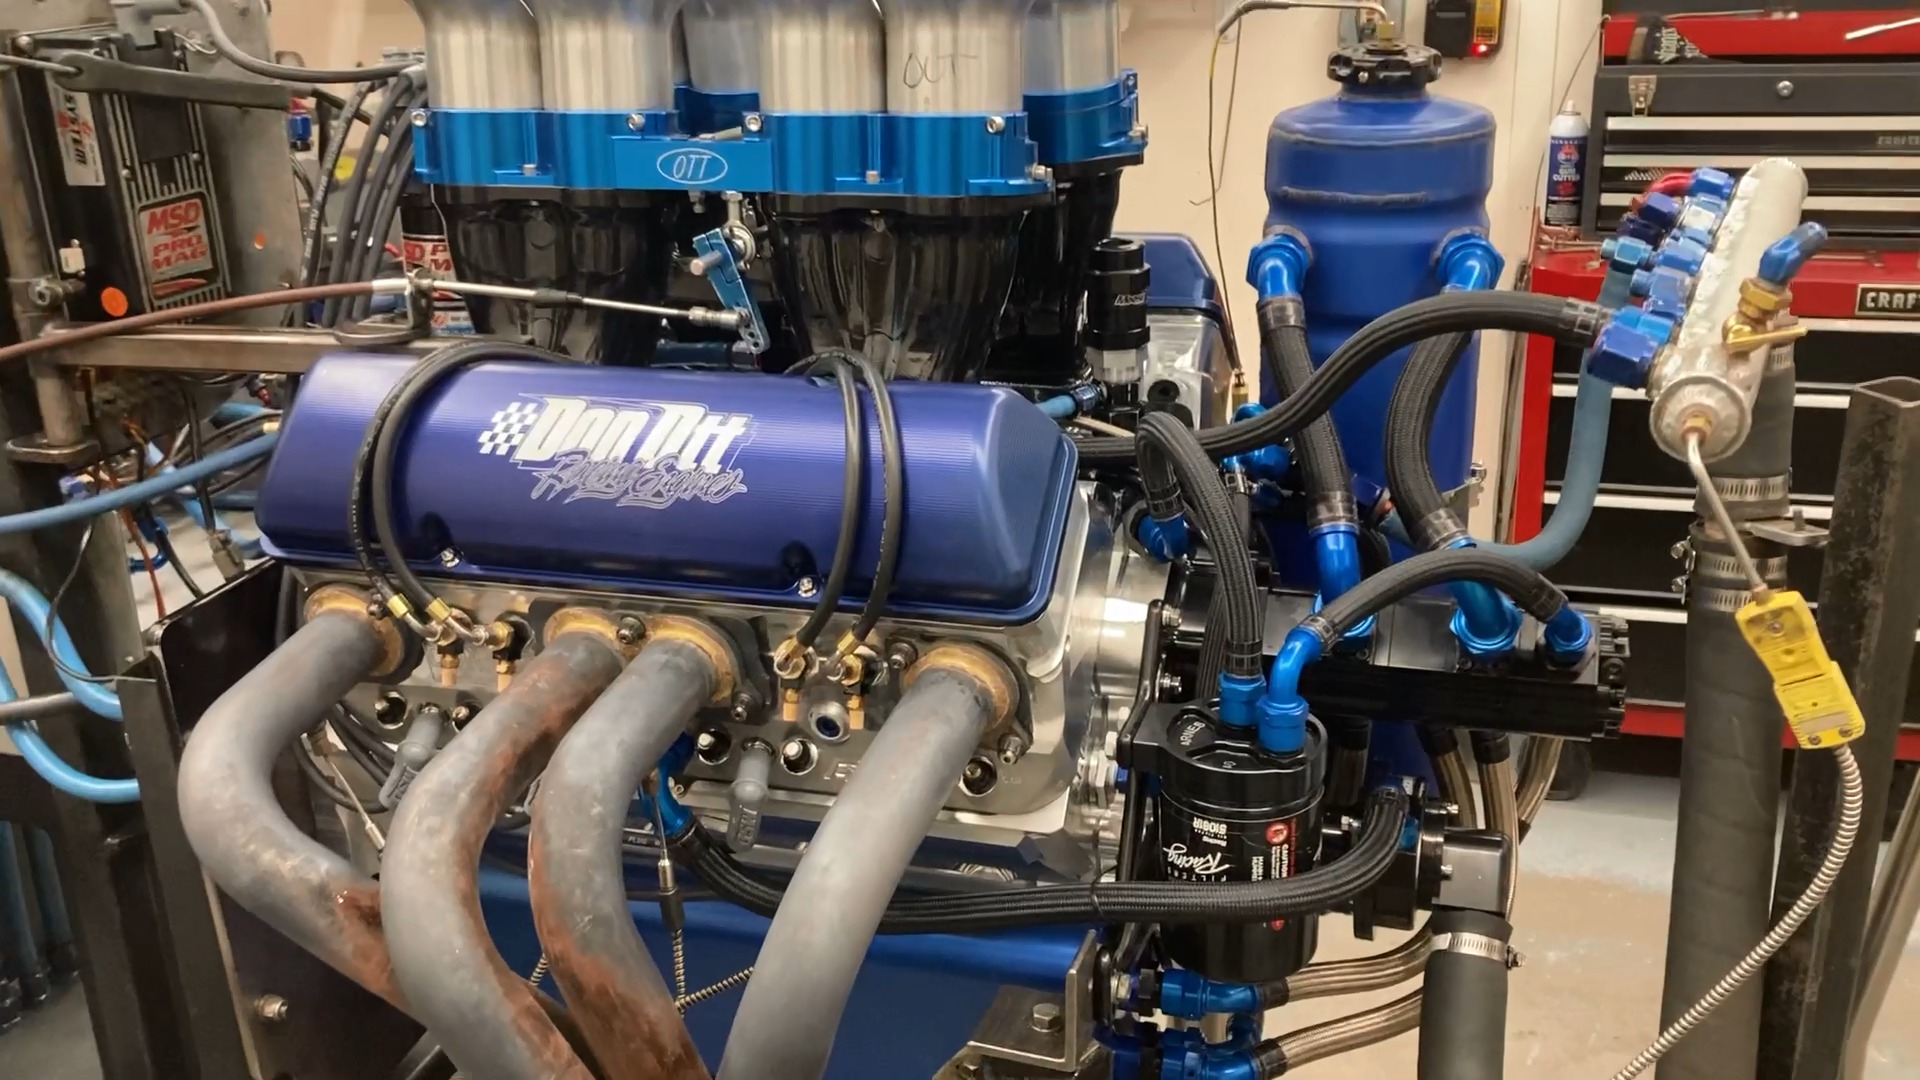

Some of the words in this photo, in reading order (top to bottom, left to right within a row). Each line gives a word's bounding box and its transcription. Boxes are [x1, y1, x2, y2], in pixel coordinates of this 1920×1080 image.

[673, 154, 712, 179] OTT
[147, 201, 201, 235] MSD
[151, 243, 209, 270] MAG
[153, 234, 203, 258] PRO
[1866, 290, 1920, 309] CRAF
[513, 397, 650, 464] Don
[636, 402, 749, 475] Ott
[1162, 843, 1231, 875] Racing
[1281, 843, 1290, 878] CAUTION
